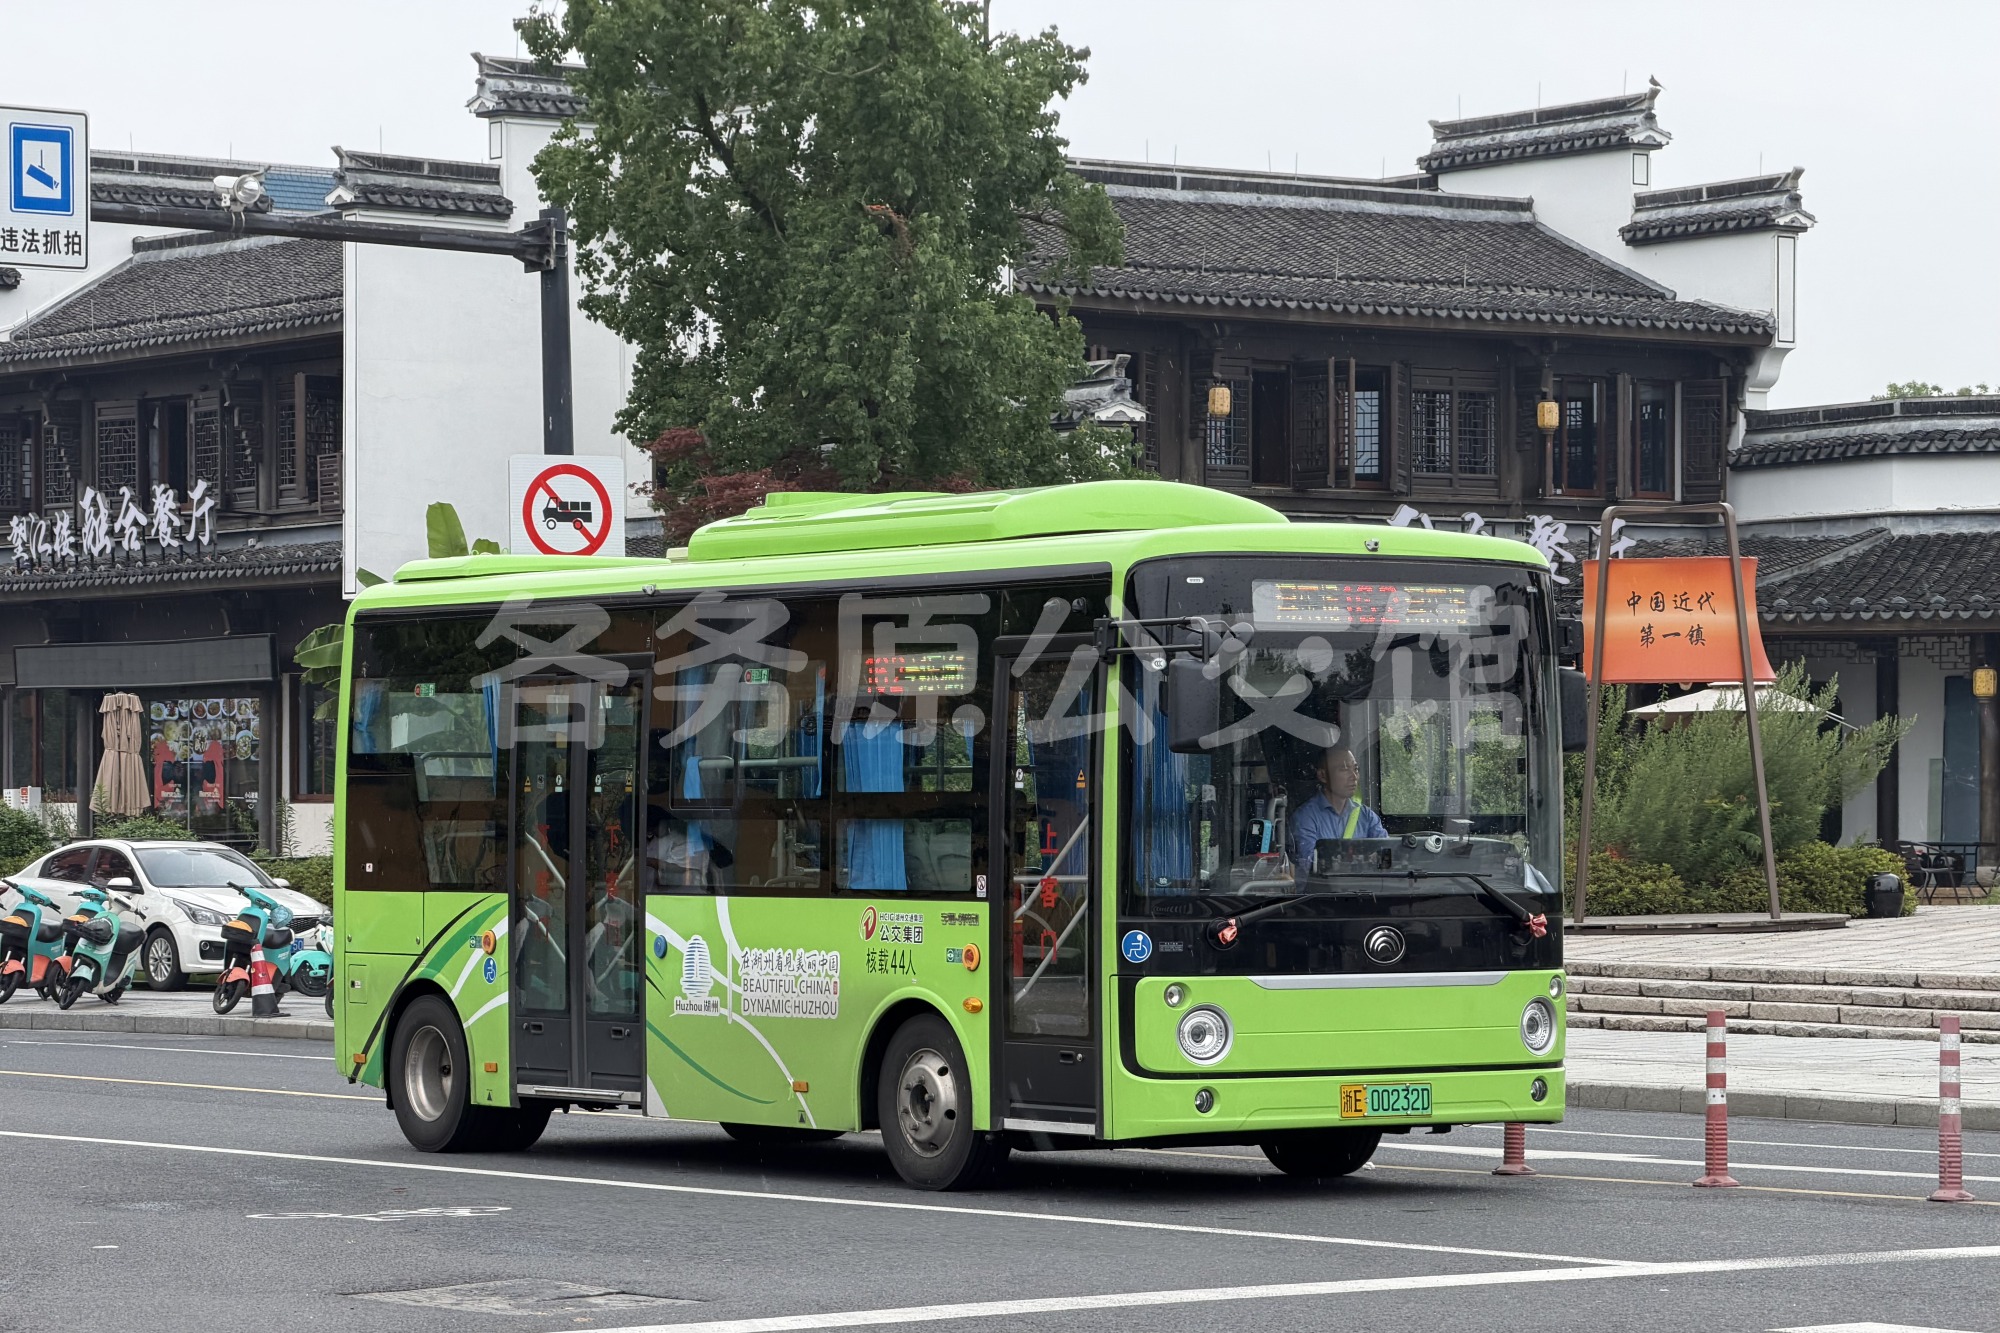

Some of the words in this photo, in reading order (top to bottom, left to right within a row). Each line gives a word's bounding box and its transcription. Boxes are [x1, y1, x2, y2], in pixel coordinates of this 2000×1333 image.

[1, 227, 82, 256] 违法抓拍
[1626, 590, 1717, 616] 中国近代
[1640, 623, 1706, 649] 第一镇
[1040, 823, 1059, 965] 上客门
[880, 925, 923, 943] 公交集团
[740, 950, 838, 974] 在湖州看见美丽中国
[866, 948, 916, 976] 核载44人
[743, 978, 796, 994] BEAUTIFUL
[799, 980, 831, 995] CHINA
[676, 1000, 703, 1011] Huzhou
[743, 999, 792, 1014] DYNAMIC
[794, 1001, 837, 1016] HUZHOU
